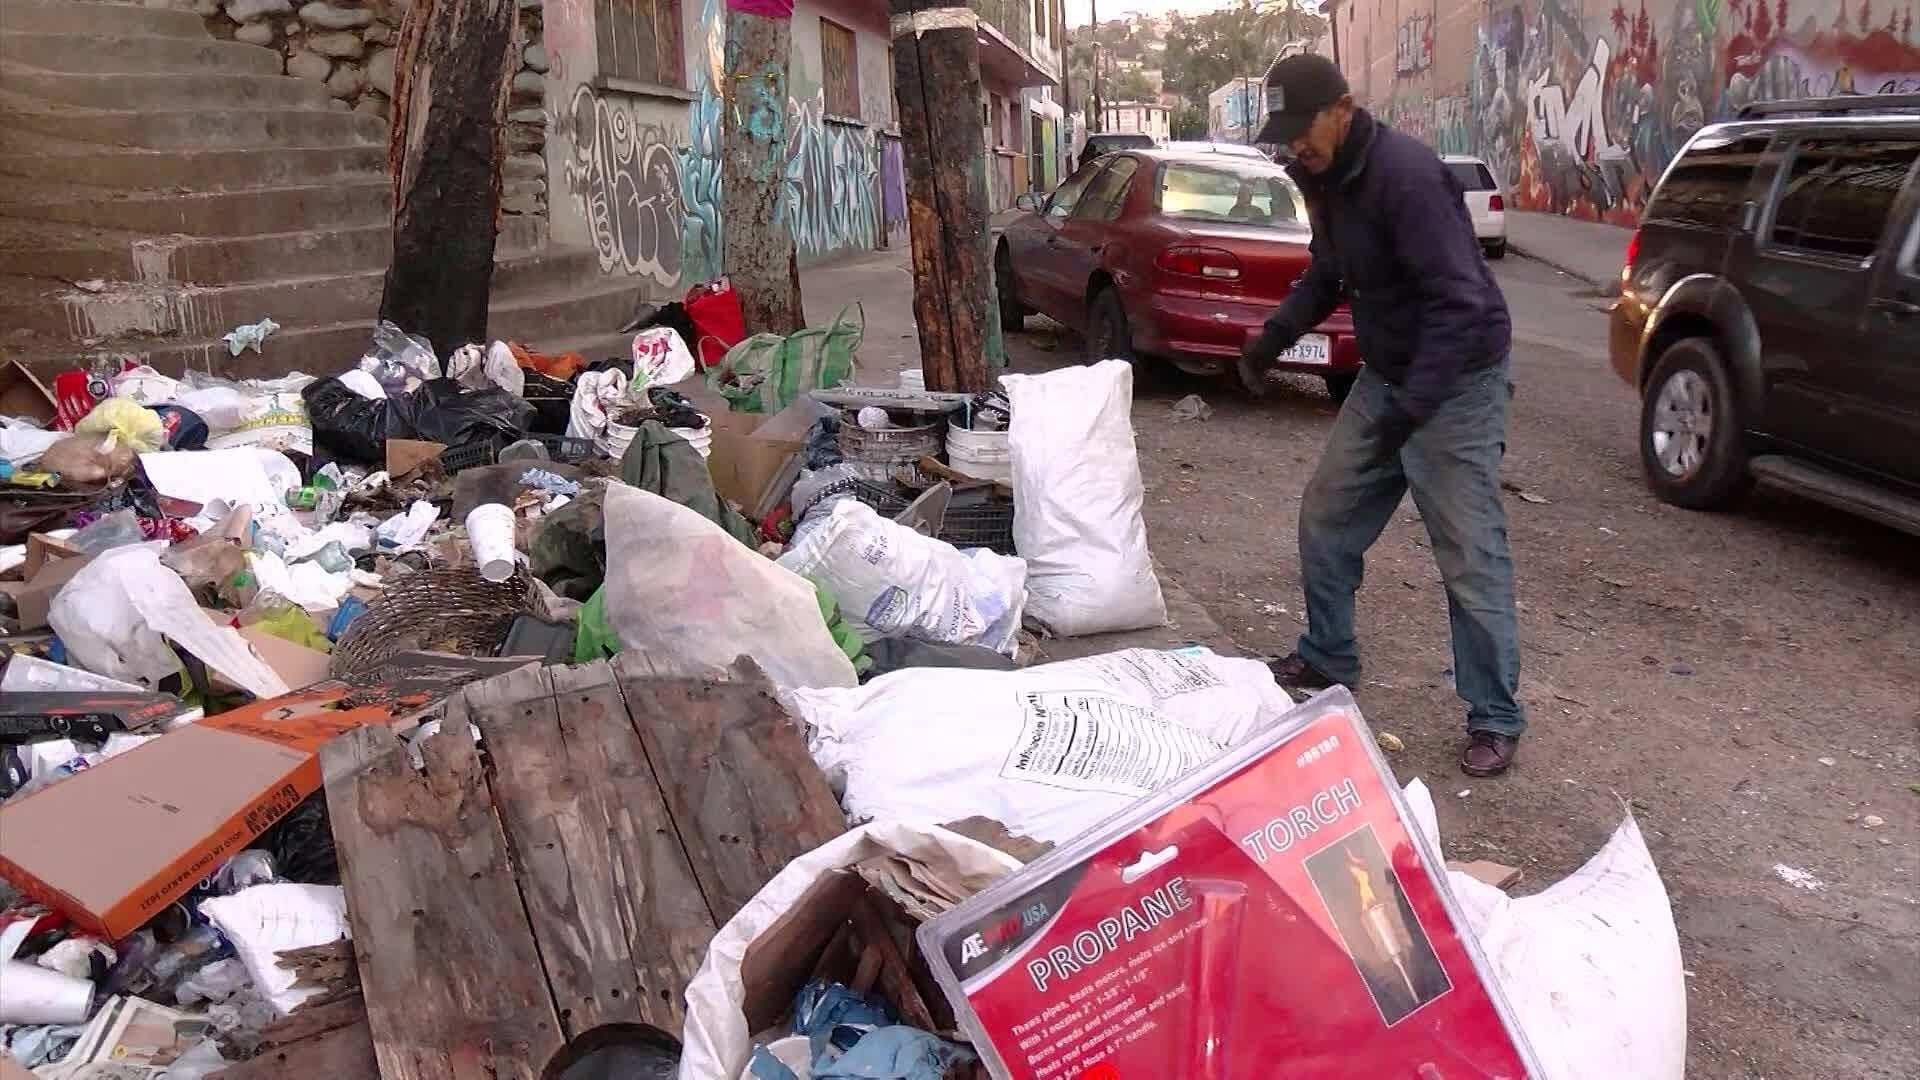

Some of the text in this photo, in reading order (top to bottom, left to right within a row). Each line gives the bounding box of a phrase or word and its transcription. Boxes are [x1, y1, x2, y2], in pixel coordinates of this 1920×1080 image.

[1242, 778, 1362, 863] TORCH
[1027, 877, 1193, 992] PROPANE
[1168, 929, 1185, 946] and
[1148, 995, 1165, 1012] and
[1085, 1015, 1101, 1032] and
